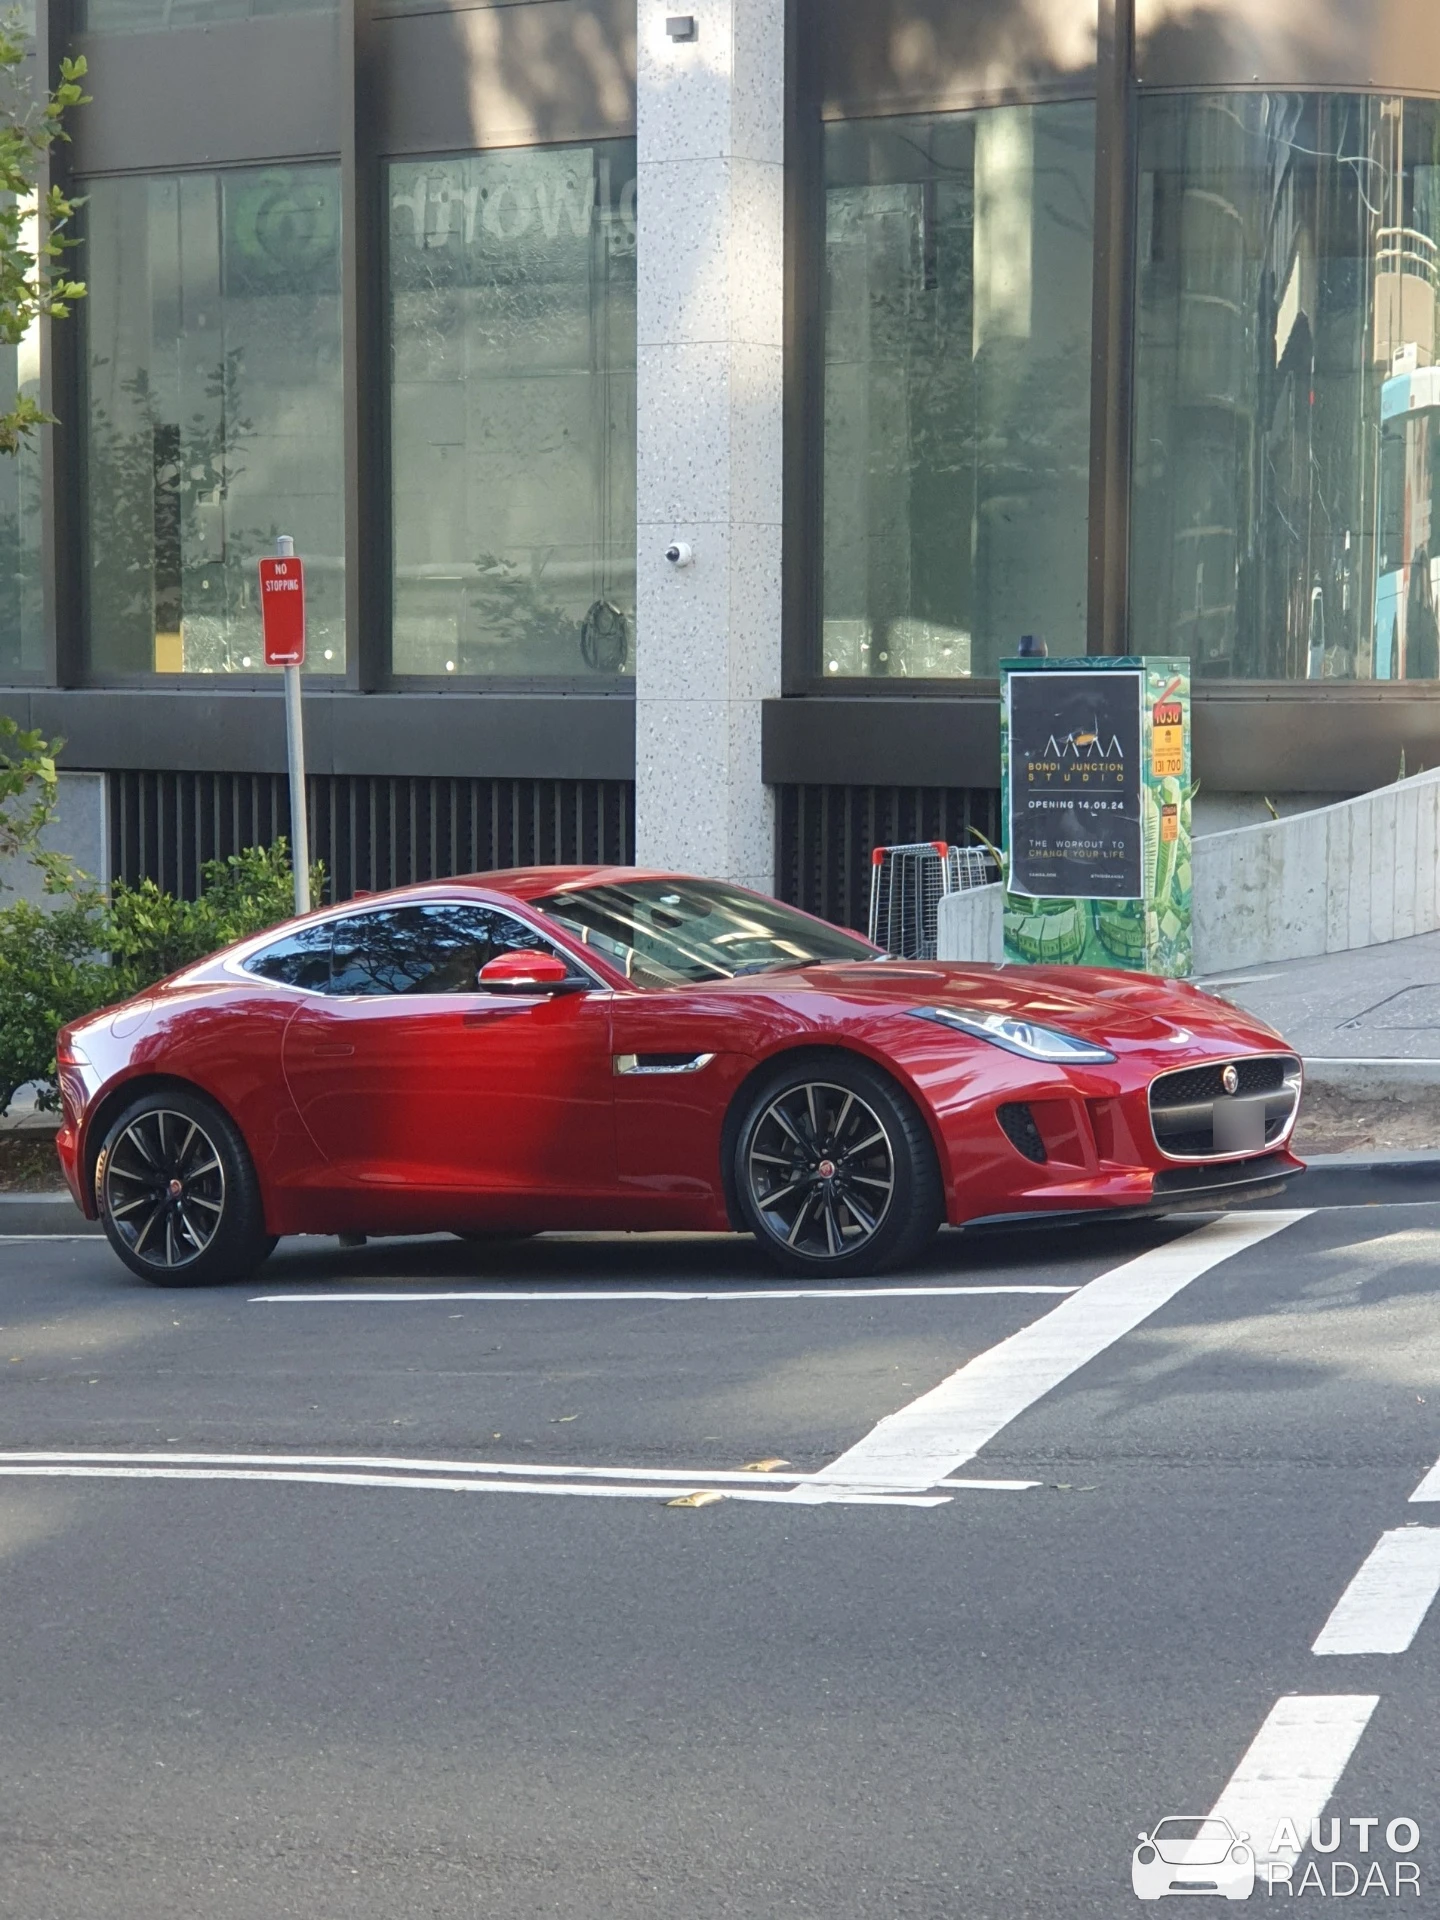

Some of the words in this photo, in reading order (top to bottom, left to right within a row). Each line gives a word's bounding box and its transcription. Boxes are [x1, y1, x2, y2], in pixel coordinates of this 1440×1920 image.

[274, 563, 287, 575] NO
[265, 579, 299, 592] STOPPING
[1028, 762, 1060, 771] BONDI
[1070, 763, 1124, 771] JUNCTION
[1166, 759, 1181, 771] 700
[1028, 773, 1124, 782] STUDIO
[1028, 800, 1074, 809] OPENING
[1078, 801, 1124, 810] 14.09.24
[1029, 839, 1048, 848] THE
[1056, 840, 1104, 848] WORKOUT
[1112, 840, 1125, 849] TO
[1028, 849, 1068, 857] CHANGE
[1072, 850, 1099, 858] YOUR
[1103, 850, 1125, 859] LIFE
